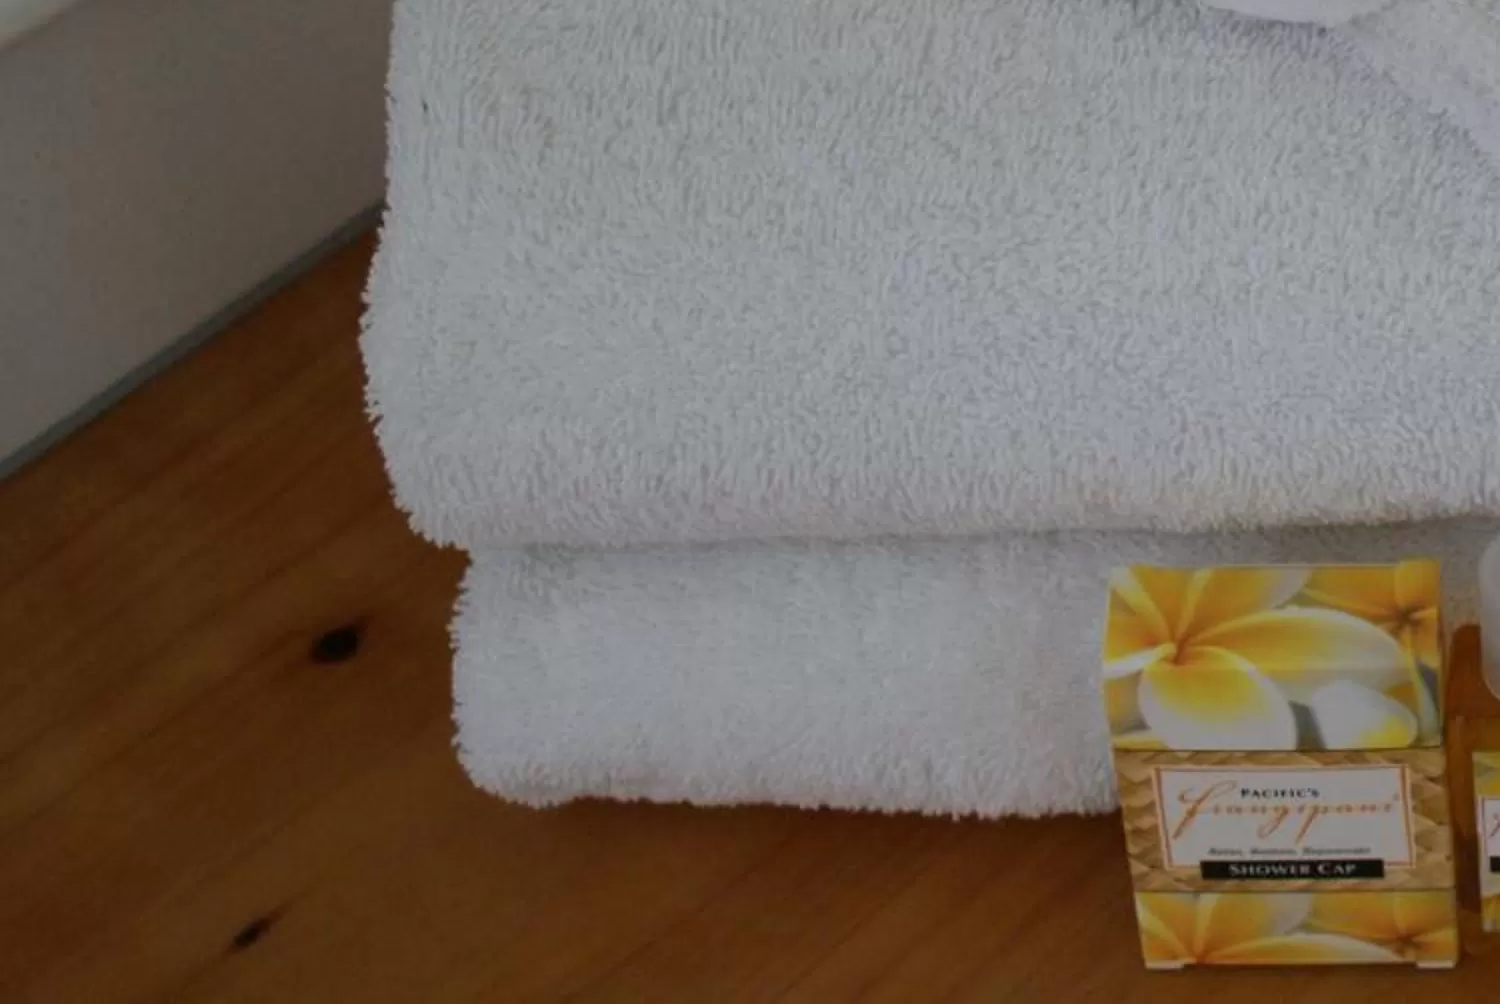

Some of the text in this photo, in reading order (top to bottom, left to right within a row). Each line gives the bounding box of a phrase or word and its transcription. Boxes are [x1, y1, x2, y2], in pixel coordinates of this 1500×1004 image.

[1239, 787, 1320, 799] PACIFIC'S
[1228, 862, 1357, 877] SHOWER CAP
